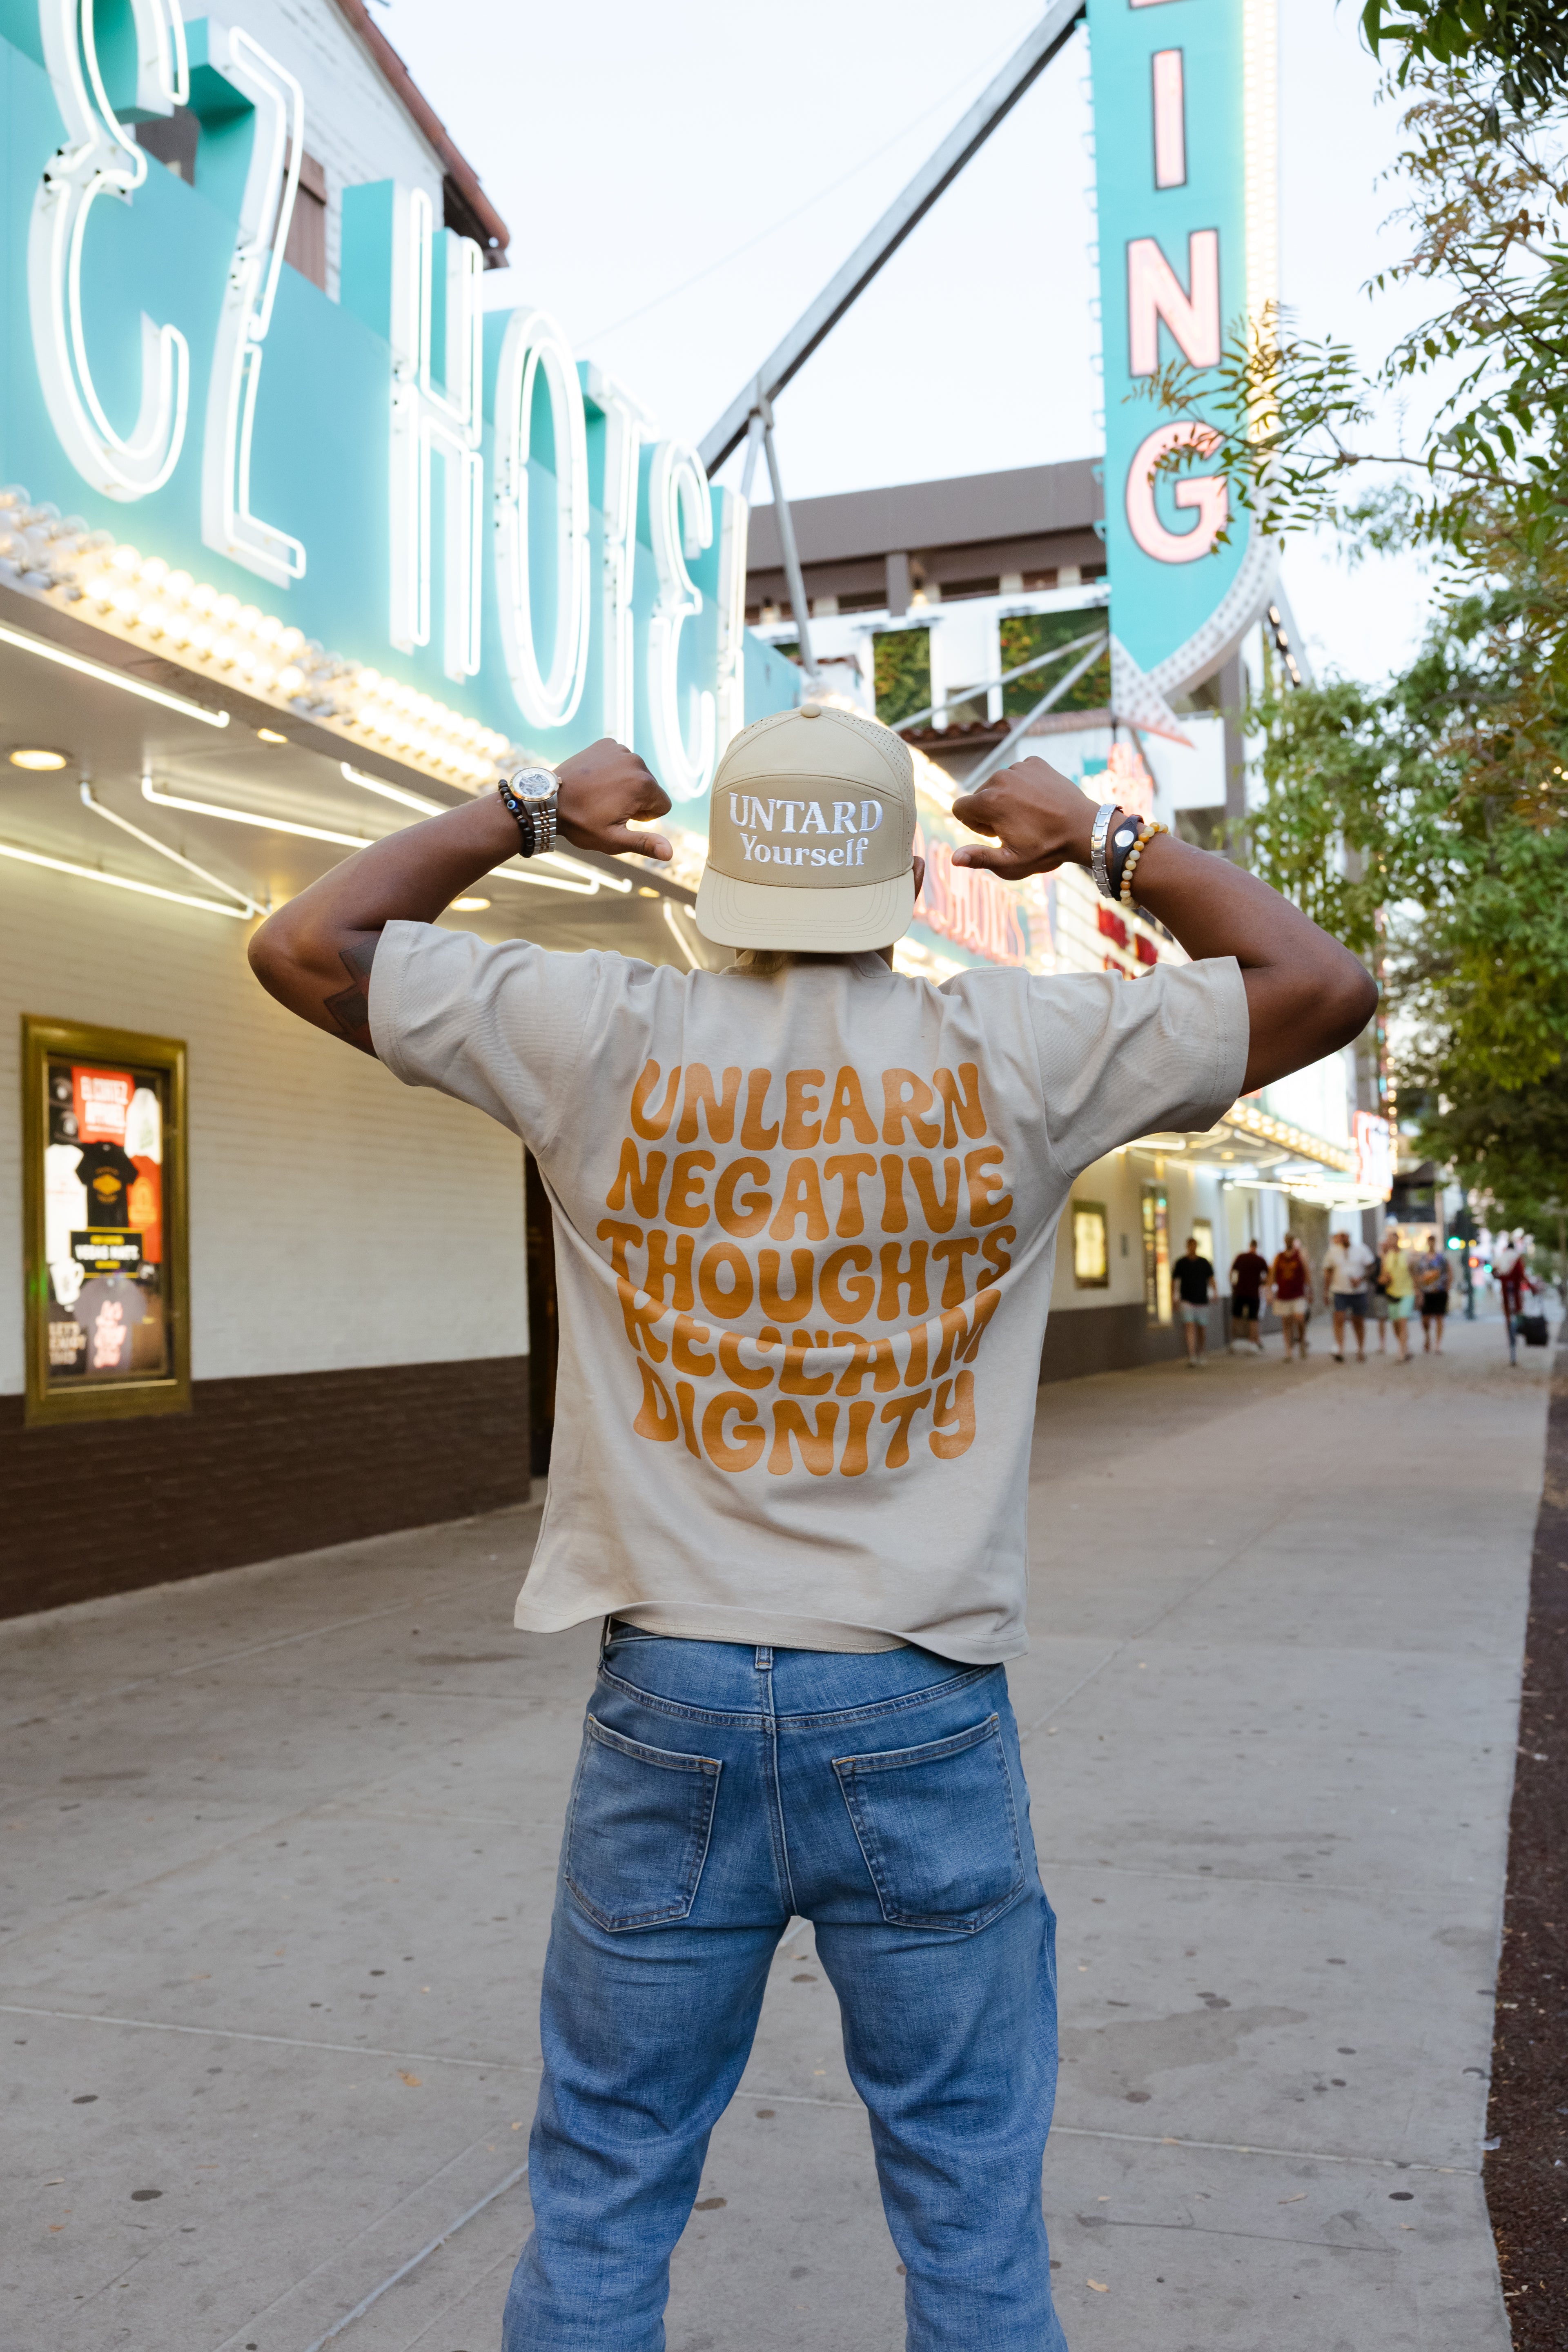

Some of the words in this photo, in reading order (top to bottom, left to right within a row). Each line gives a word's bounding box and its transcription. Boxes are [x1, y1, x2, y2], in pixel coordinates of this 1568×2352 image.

[1125, 0, 1230, 565] ING
[729, 792, 883, 835] UNTARD
[740, 833, 869, 867] Yourself
[630, 1058, 987, 1151] UNLEARN
[606, 1137, 1013, 1241] NEGATIVE
[596, 1218, 1017, 1325] THOUGHTS
[616, 1276, 1001, 1396] RECLAIM
[633, 1356, 977, 1477] DIGNITY
